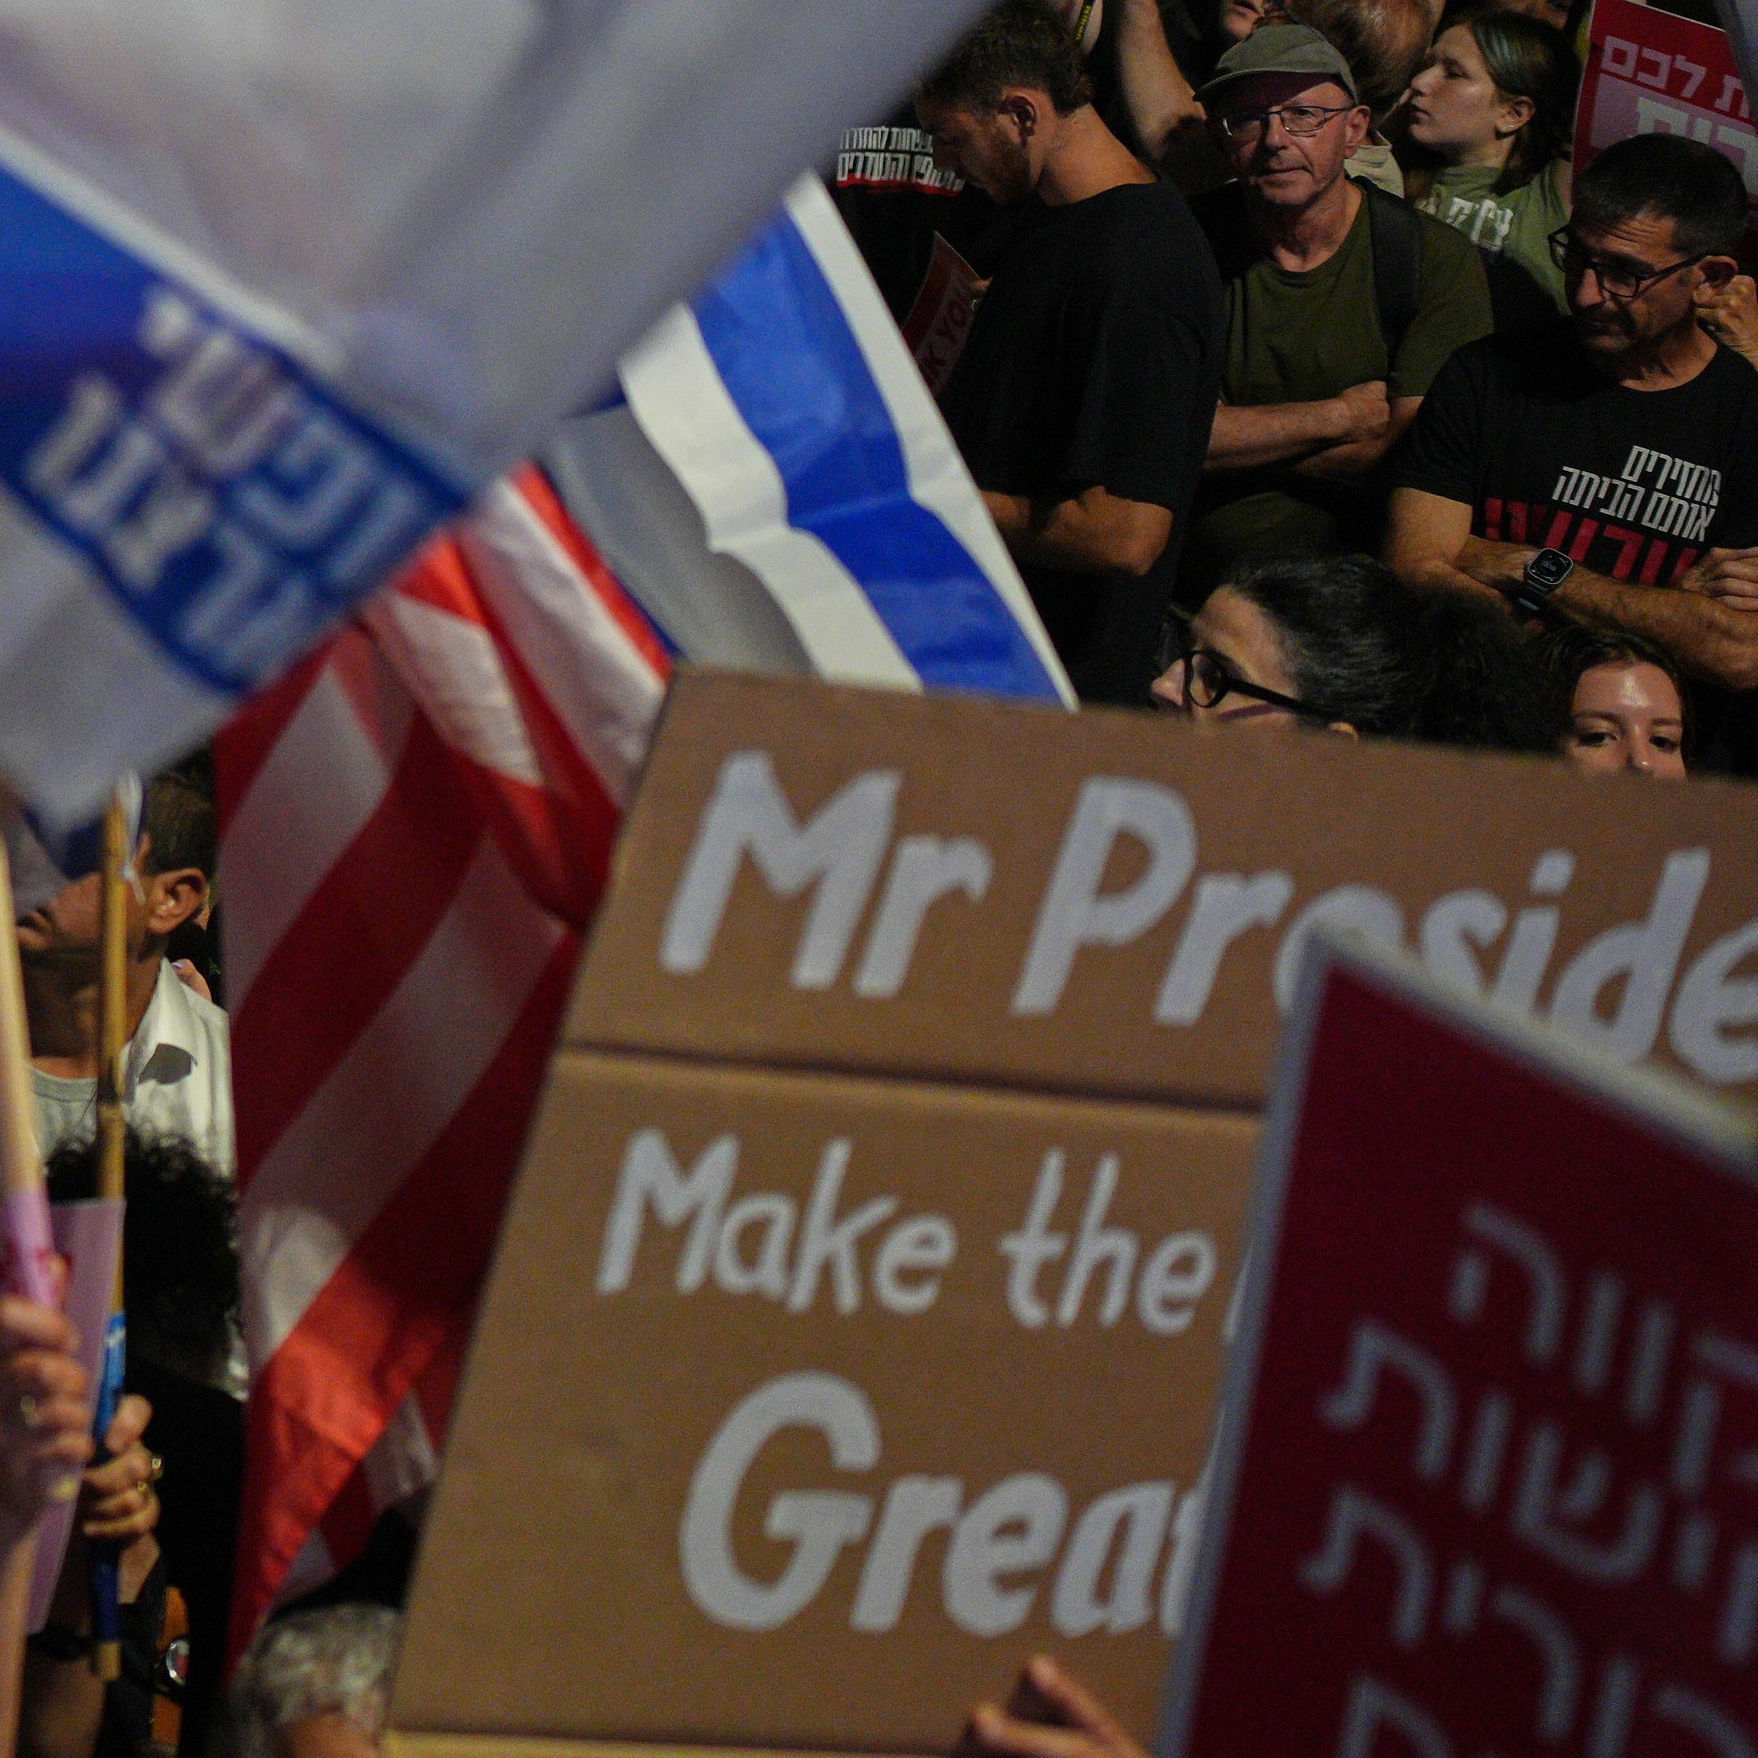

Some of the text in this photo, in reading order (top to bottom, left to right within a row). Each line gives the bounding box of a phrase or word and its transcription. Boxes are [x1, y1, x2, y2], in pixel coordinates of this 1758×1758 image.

[1601, 34, 1709, 99] לכם
[1551, 465, 1716, 543] אותם הביתה
[1621, 444, 1723, 507] מחזירים
[658, 749, 994, 1000] Mr
[594, 1127, 1218, 1334] Make the
